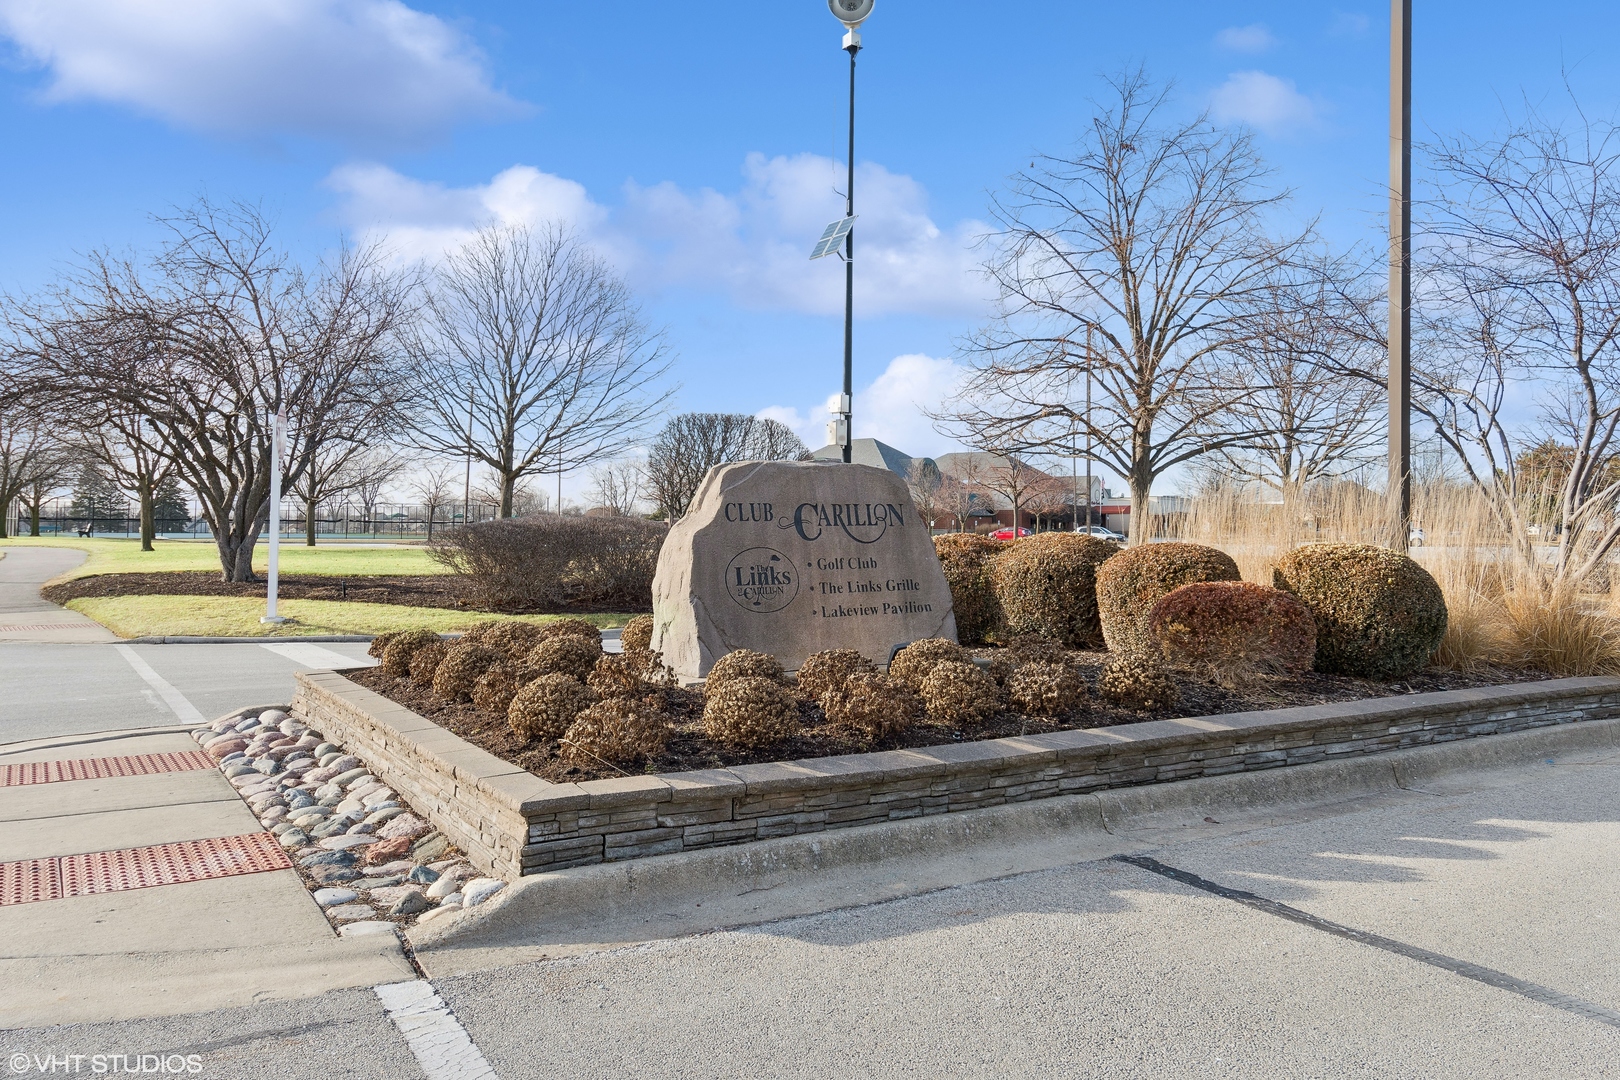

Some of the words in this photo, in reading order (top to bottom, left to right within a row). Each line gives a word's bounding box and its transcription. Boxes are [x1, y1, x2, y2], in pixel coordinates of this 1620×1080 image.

[724, 502, 774, 523] CLUB
[777, 502, 905, 544] CARILLON
[817, 557, 845, 571] Golf
[848, 557, 878, 570] Club
[734, 566, 792, 587] Links
[819, 581, 844, 595] The
[847, 580, 882, 594] Links
[886, 579, 920, 592] Grille
[821, 604, 879, 618] Lakeview
[882, 601, 933, 615] Pavilion
